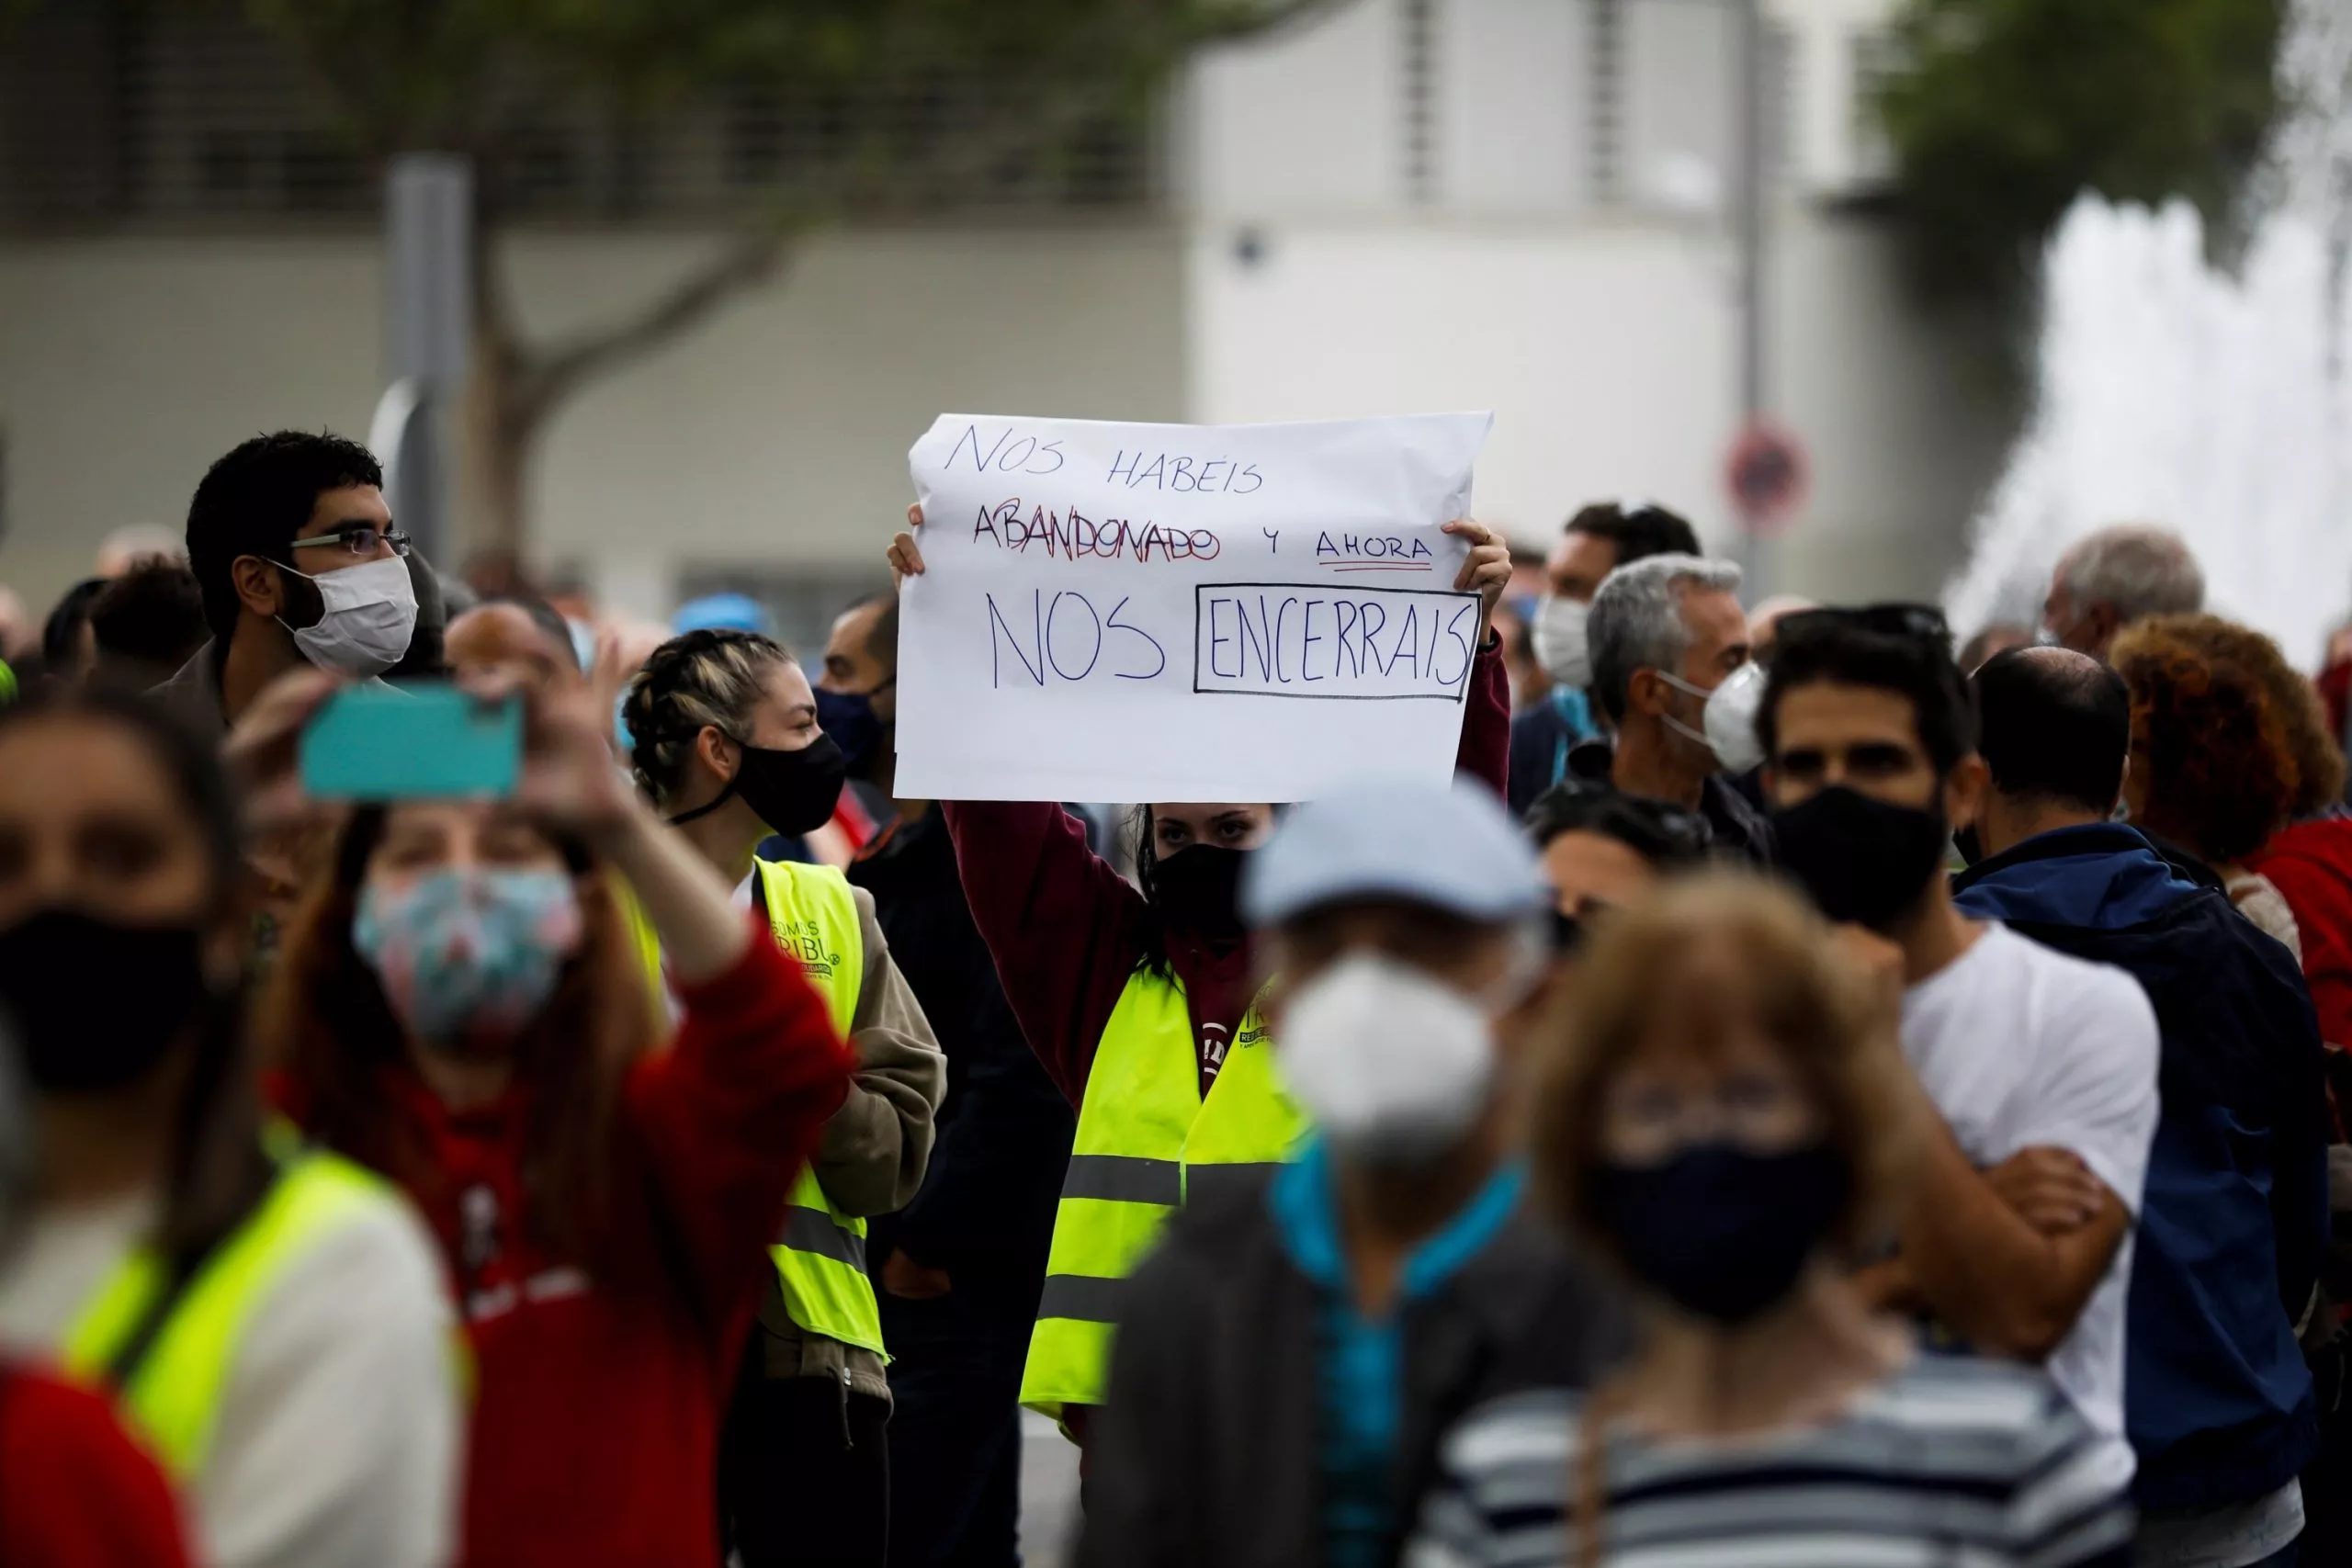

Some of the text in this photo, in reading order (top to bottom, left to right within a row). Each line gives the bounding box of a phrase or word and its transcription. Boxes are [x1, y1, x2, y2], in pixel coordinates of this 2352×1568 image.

[944, 423, 1065, 474] NOS
[974, 497, 1433, 563] ABANDONADO Y AHORA
[986, 588, 1473, 689] NOS ENCERRAIS
[771, 920, 820, 935] SOMOS
